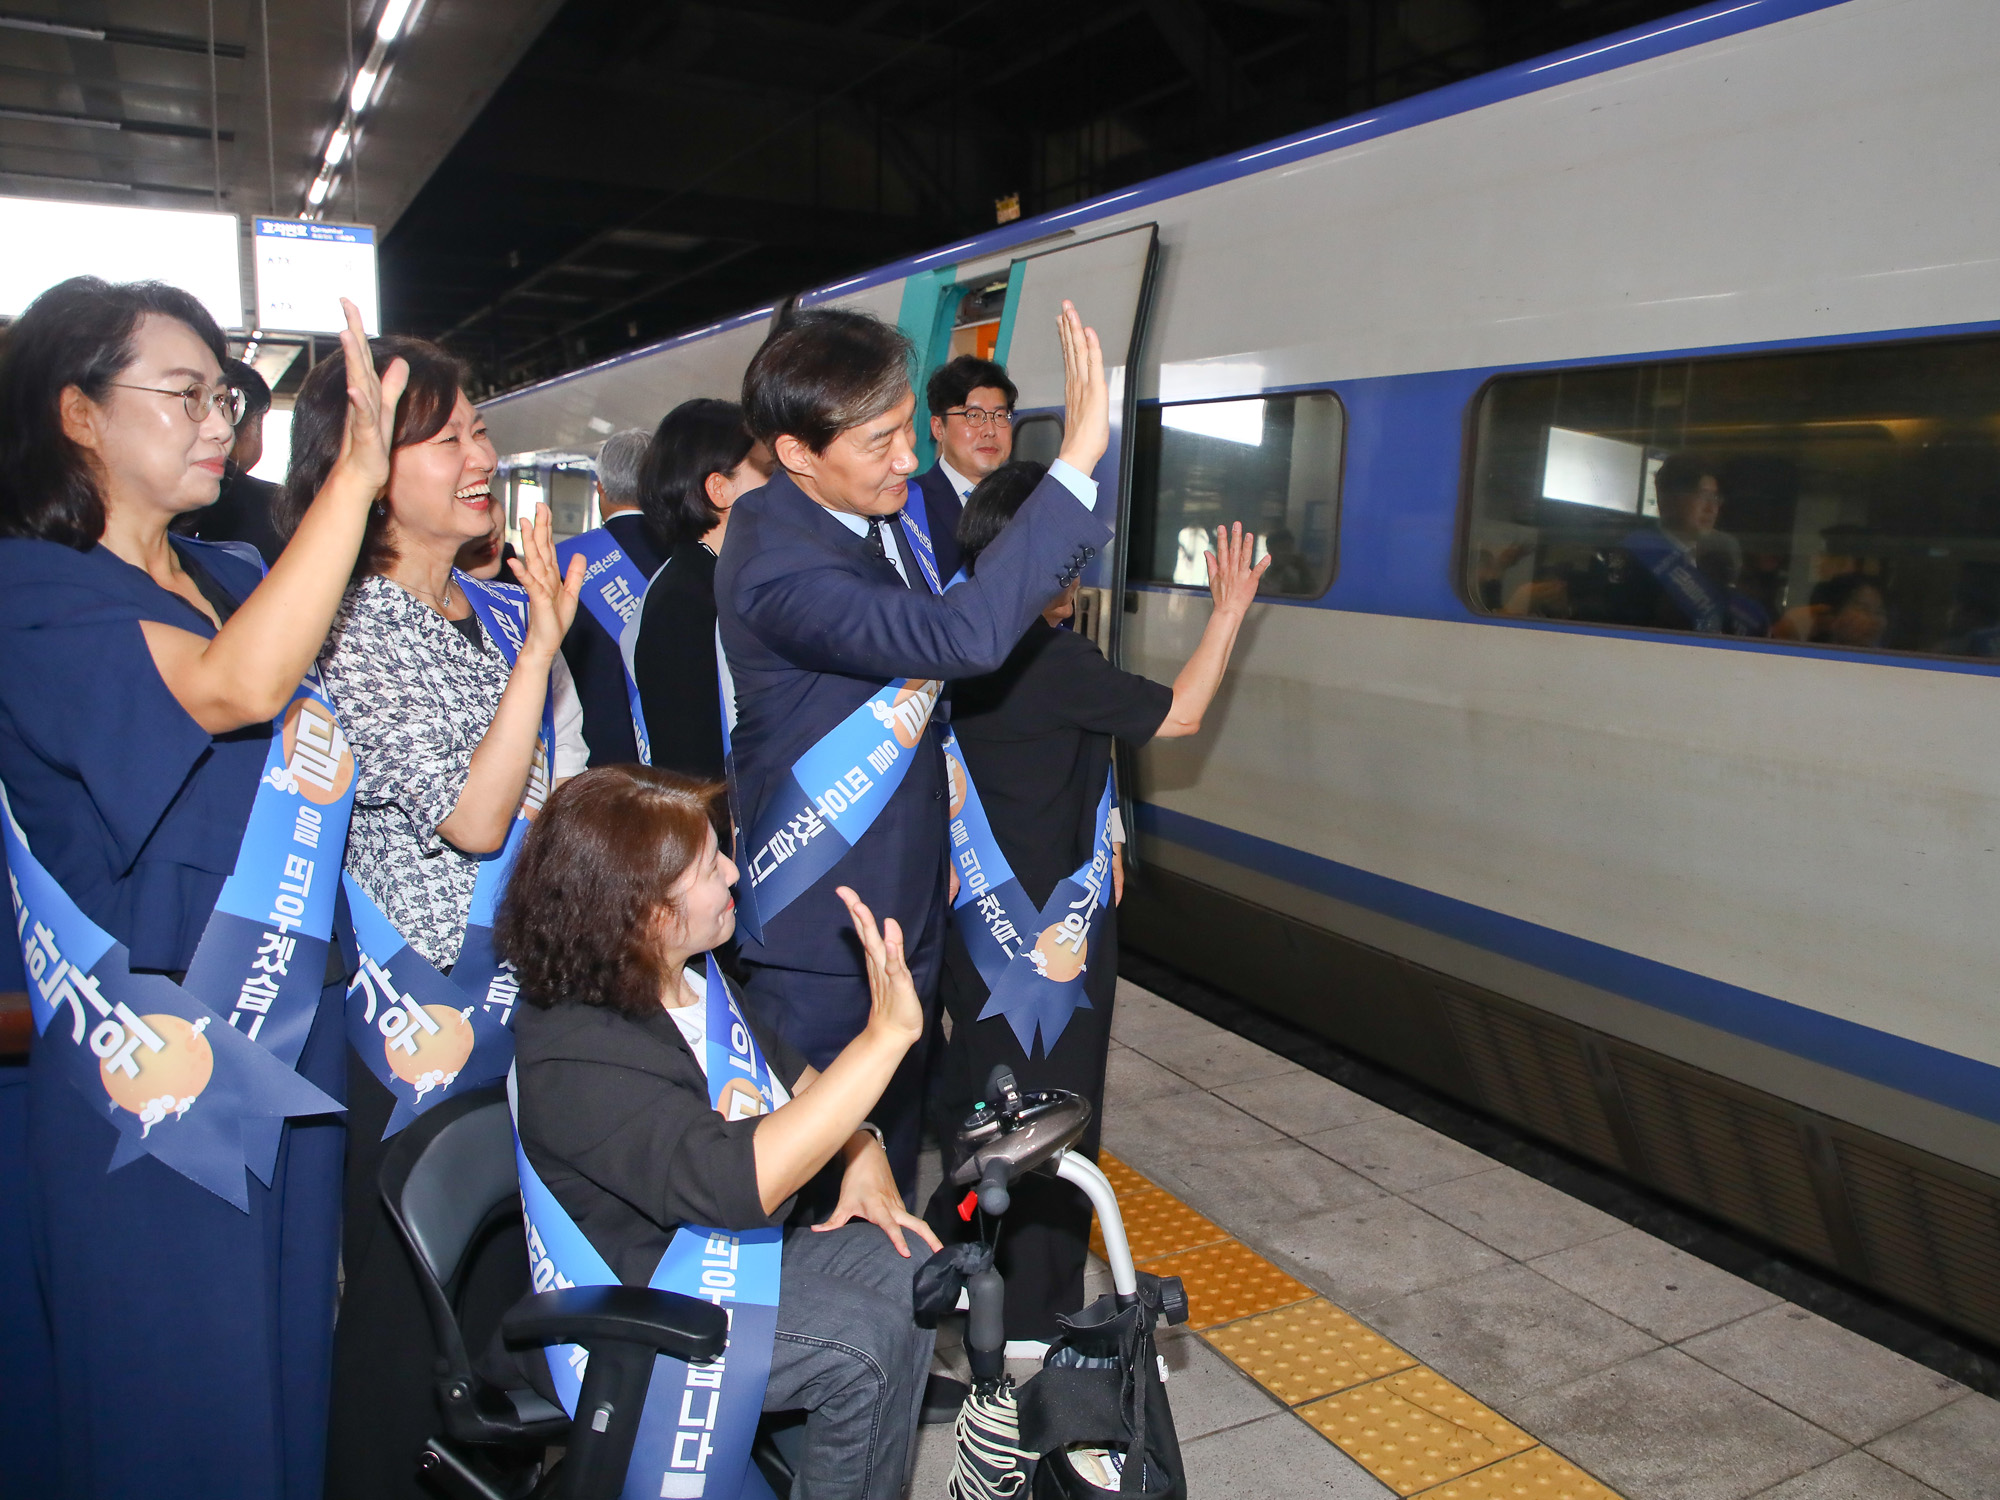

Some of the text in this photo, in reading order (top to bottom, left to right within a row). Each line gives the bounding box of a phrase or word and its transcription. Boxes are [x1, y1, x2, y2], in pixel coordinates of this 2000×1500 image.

[582, 549, 622, 587] 국혁신당
[749, 765, 874, 888] 띄우겠습니
[24, 920, 165, 1080] 한가위
[348, 945, 440, 1057] 가위
[671, 1232, 740, 1471] 띄우습니다
